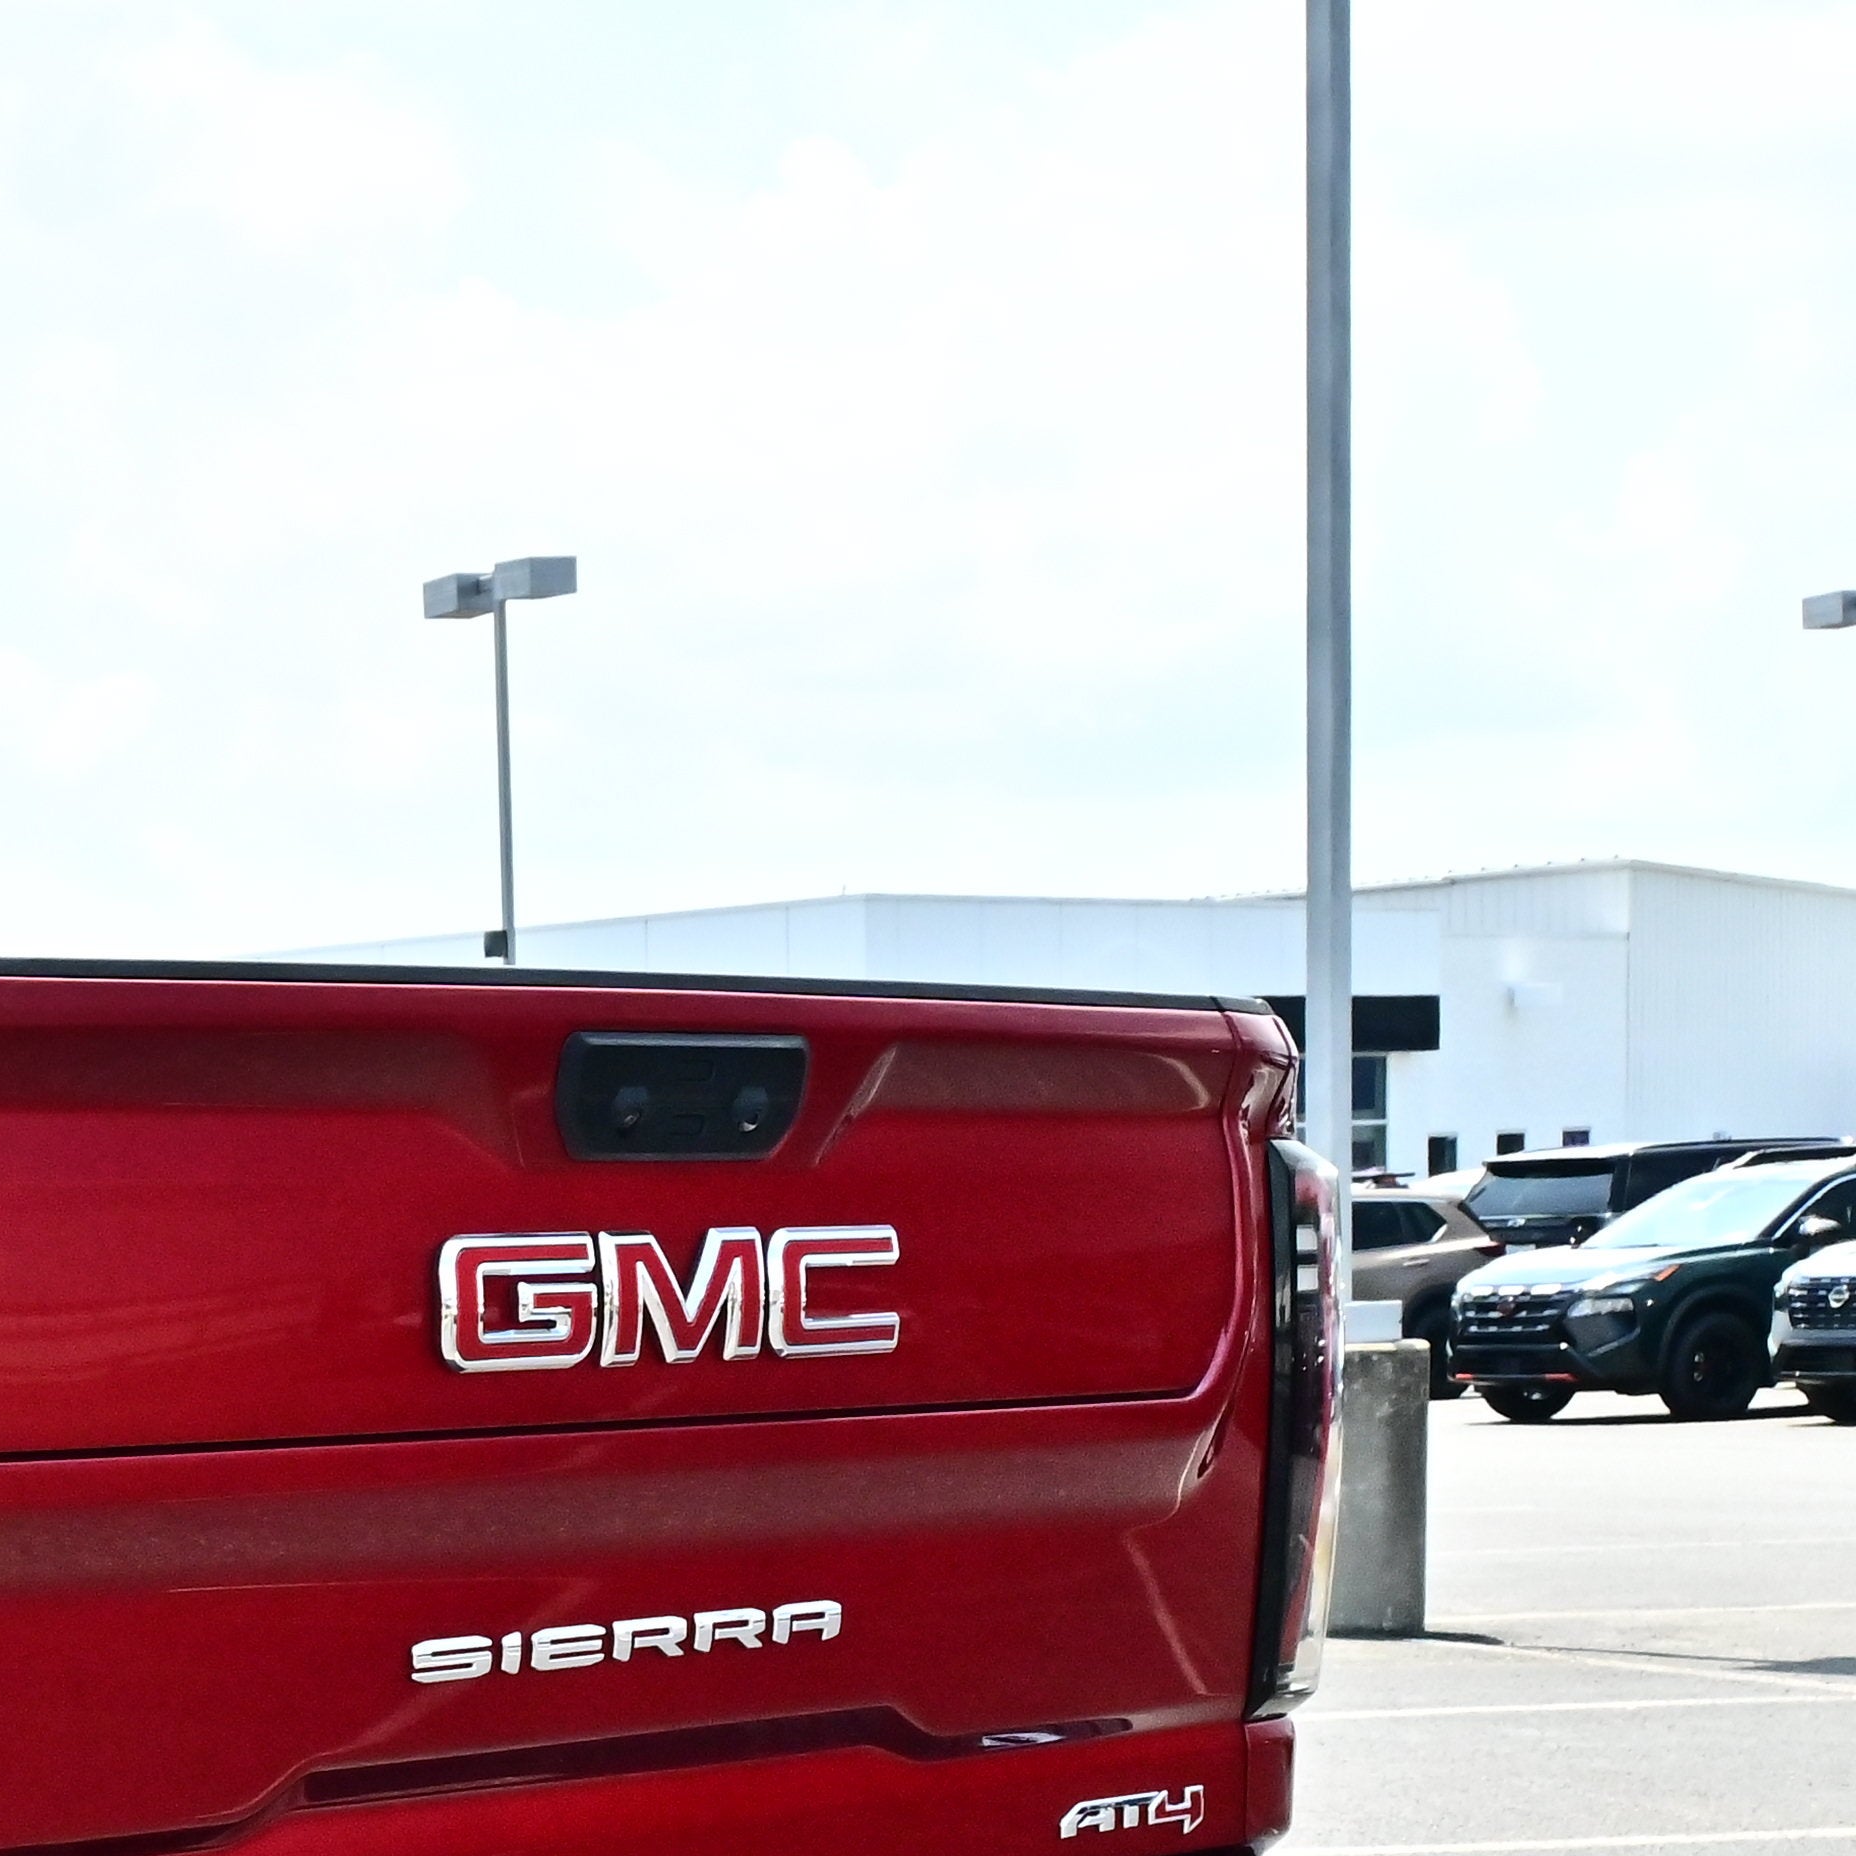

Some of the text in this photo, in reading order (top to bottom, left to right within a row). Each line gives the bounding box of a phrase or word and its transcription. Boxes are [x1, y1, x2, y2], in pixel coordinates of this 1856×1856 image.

[439, 1224, 900, 1374] GMC
[411, 1599, 843, 1684] SIERRA
[1059, 1784, 1205, 1840] AT4
